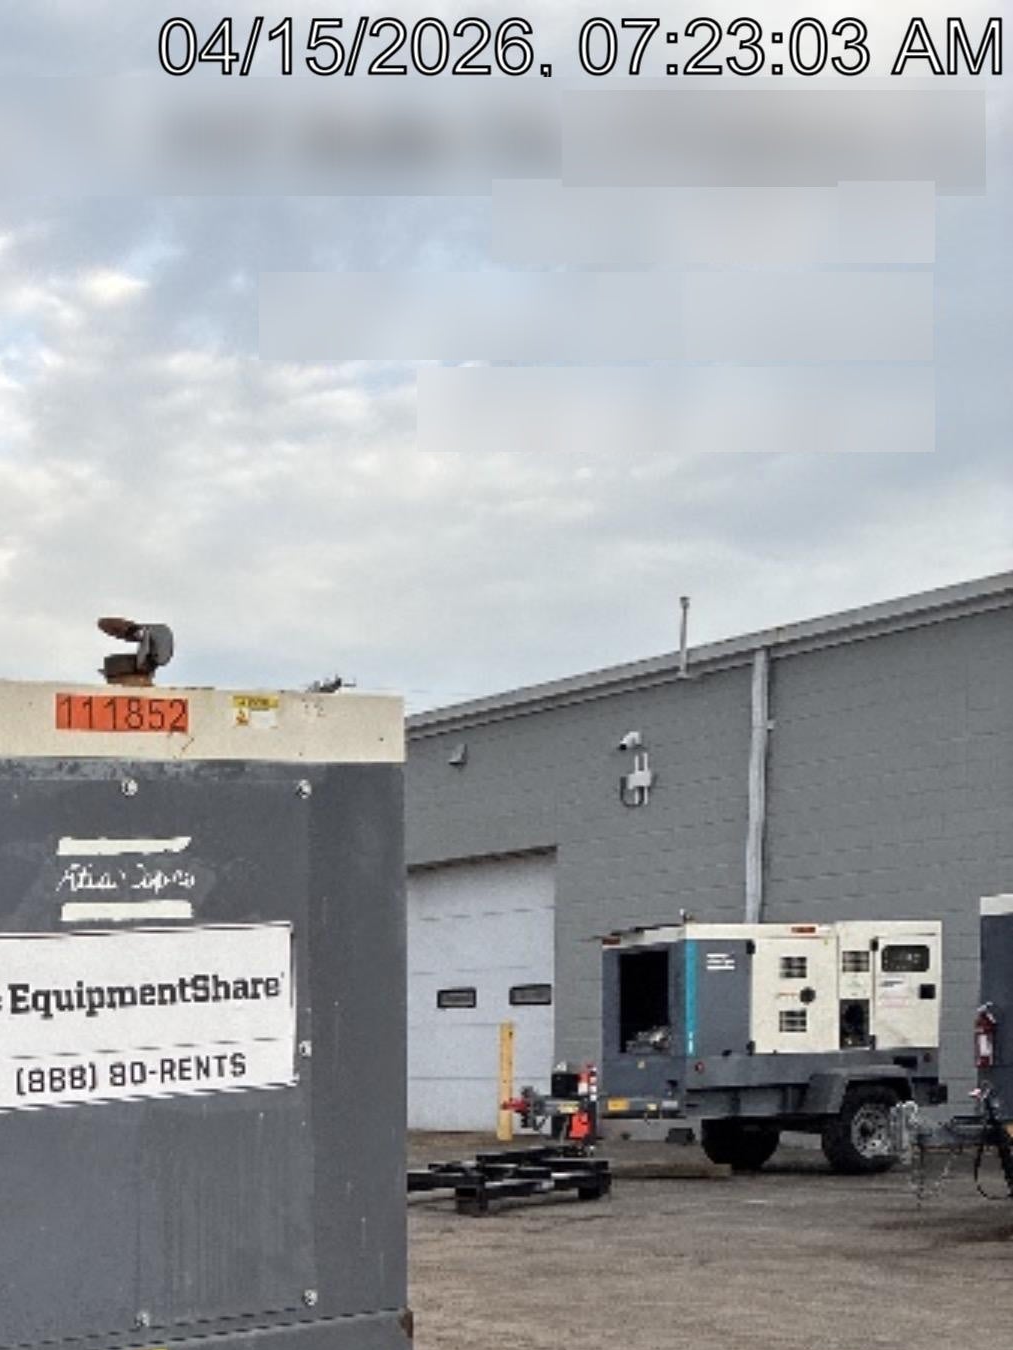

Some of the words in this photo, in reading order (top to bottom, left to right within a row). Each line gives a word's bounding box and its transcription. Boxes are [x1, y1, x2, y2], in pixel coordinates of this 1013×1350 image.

[59, 695, 187, 732] 111852
[8, 974, 280, 1020] EquipmentShare
[15, 1065, 97, 1096] (888)
[108, 1052, 247, 1088] 80-RENTS
